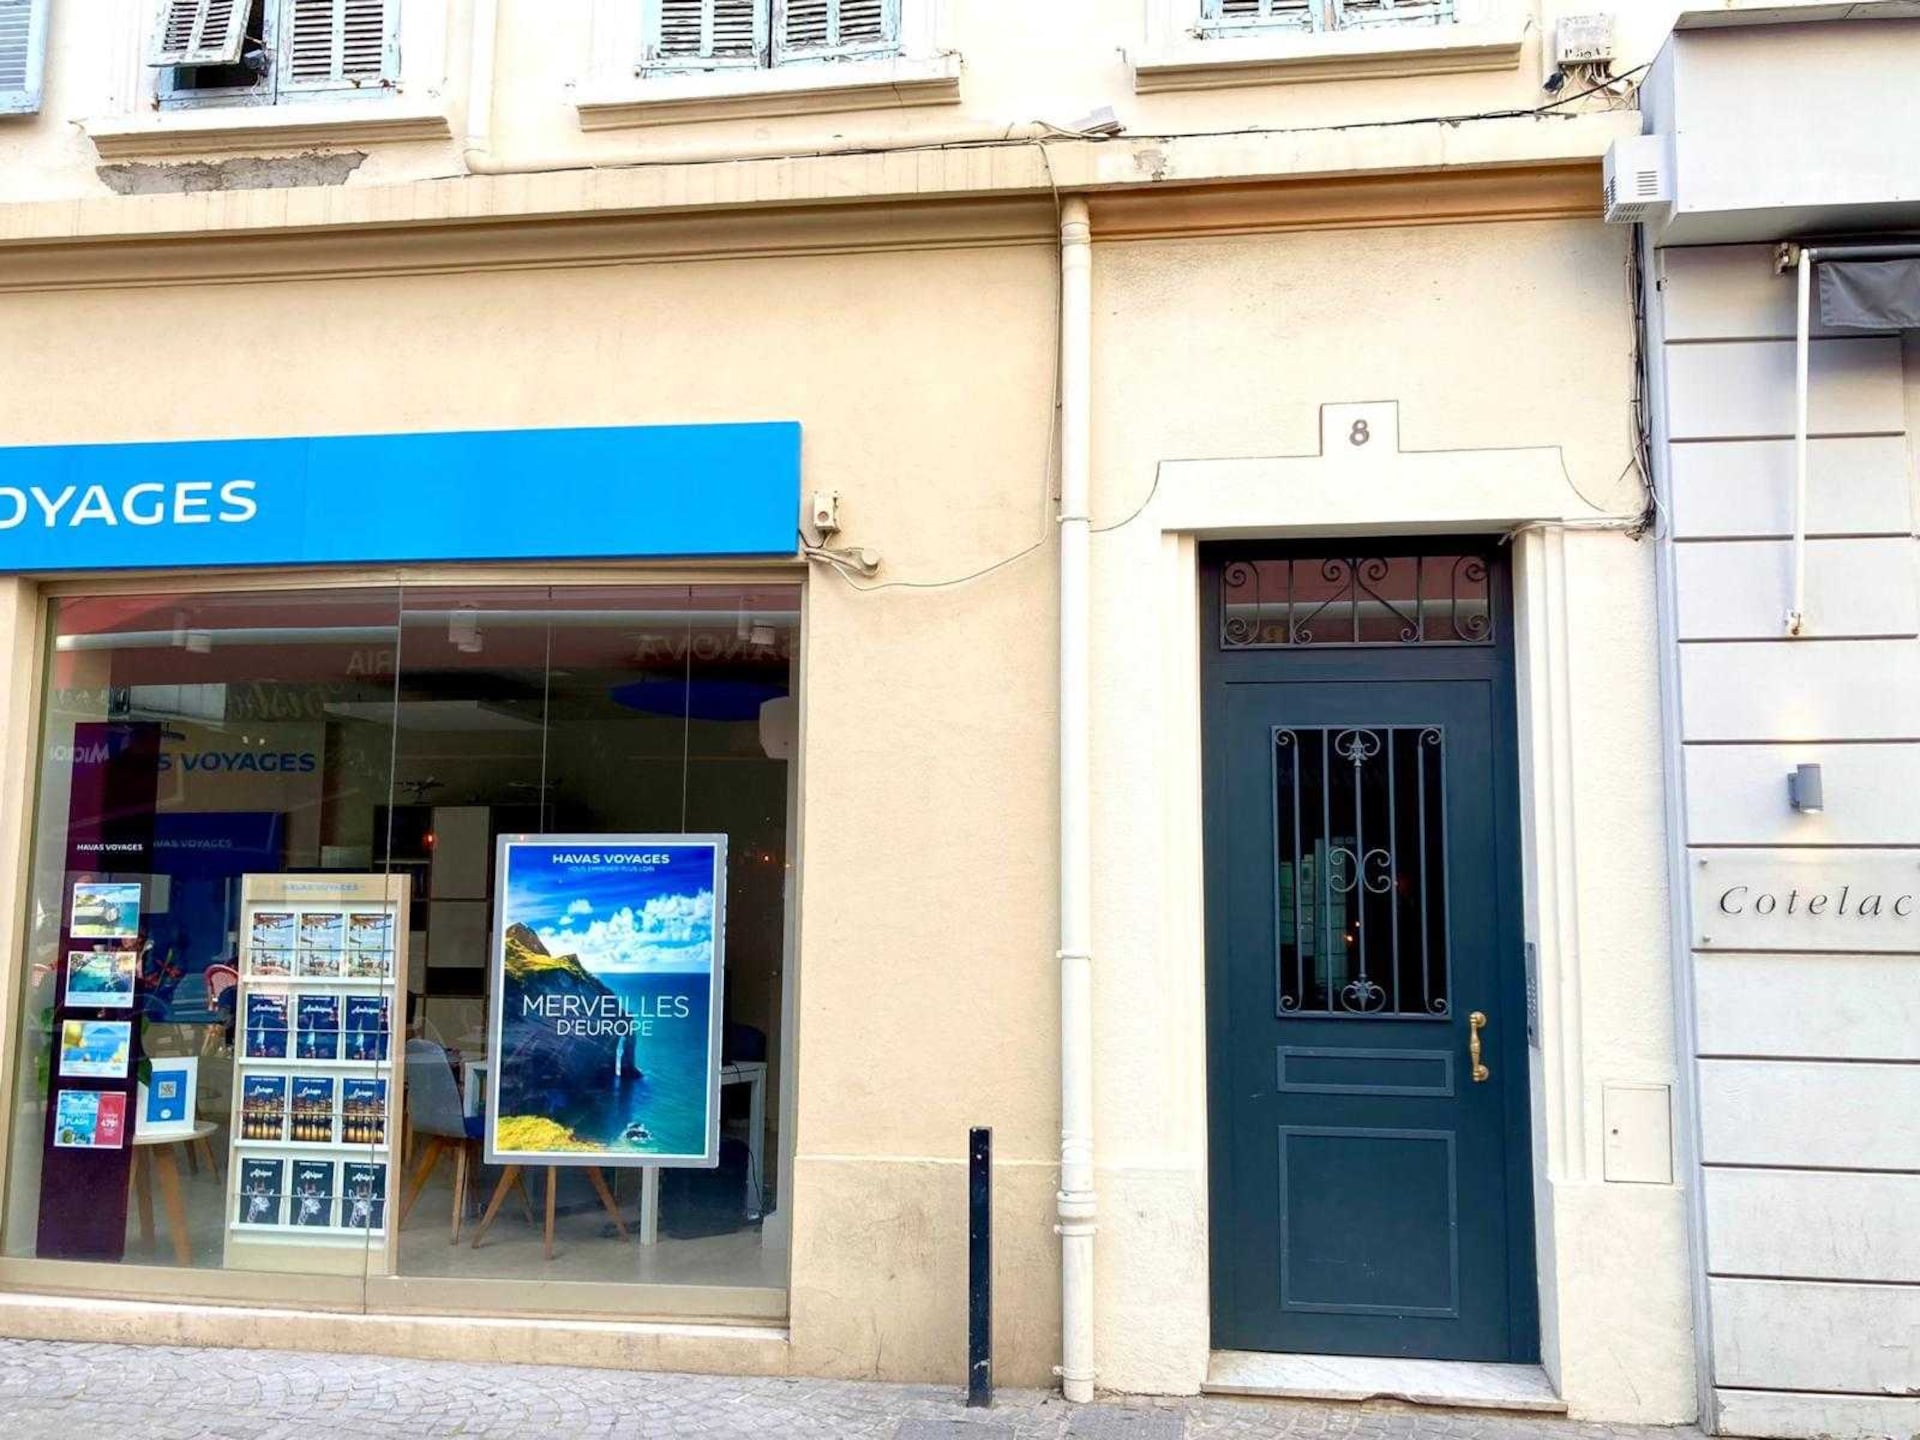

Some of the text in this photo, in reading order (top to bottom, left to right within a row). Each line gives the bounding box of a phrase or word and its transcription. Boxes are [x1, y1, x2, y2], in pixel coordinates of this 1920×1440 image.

[1350, 419, 1370, 446] 8
[182, 752, 315, 772] VOYAGES
[105, 843, 143, 851] VOYAGES
[552, 854, 670, 864] HAVAS VOYAGES
[1719, 885, 1913, 917] Cotelac
[523, 994, 689, 1018] MERVEILLES
[557, 1019, 654, 1036] D'EUROPE
